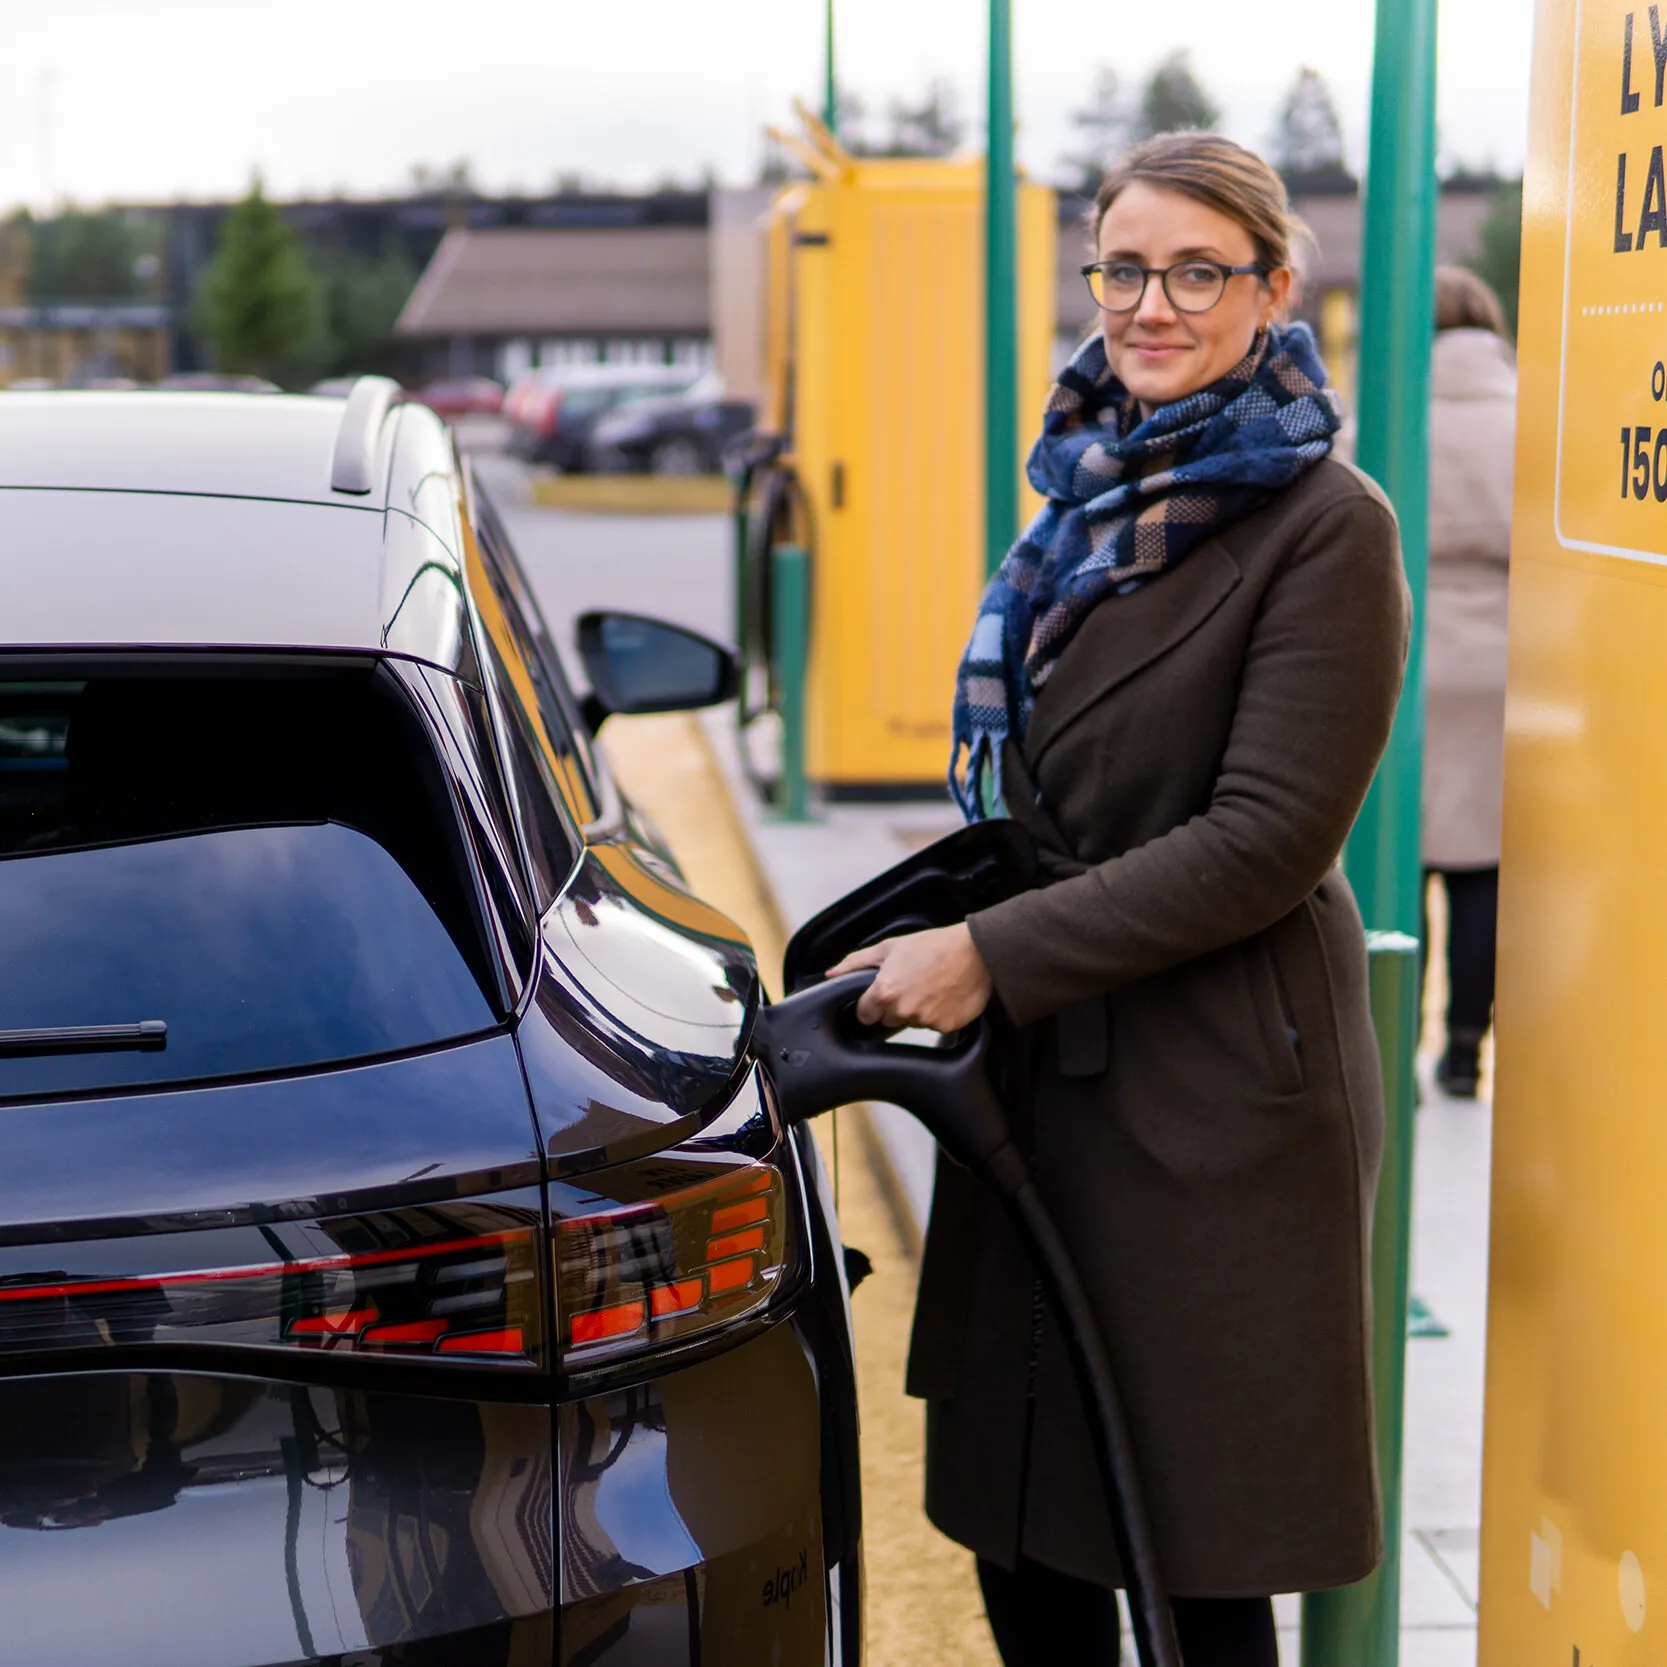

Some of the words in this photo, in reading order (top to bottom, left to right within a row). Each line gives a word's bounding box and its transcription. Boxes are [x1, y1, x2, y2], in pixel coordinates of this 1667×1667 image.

[1621, 4, 1667, 116] LY
[1613, 145, 1667, 254] LA
[1652, 361, 1667, 402] O
[1620, 426, 1667, 503] 150
